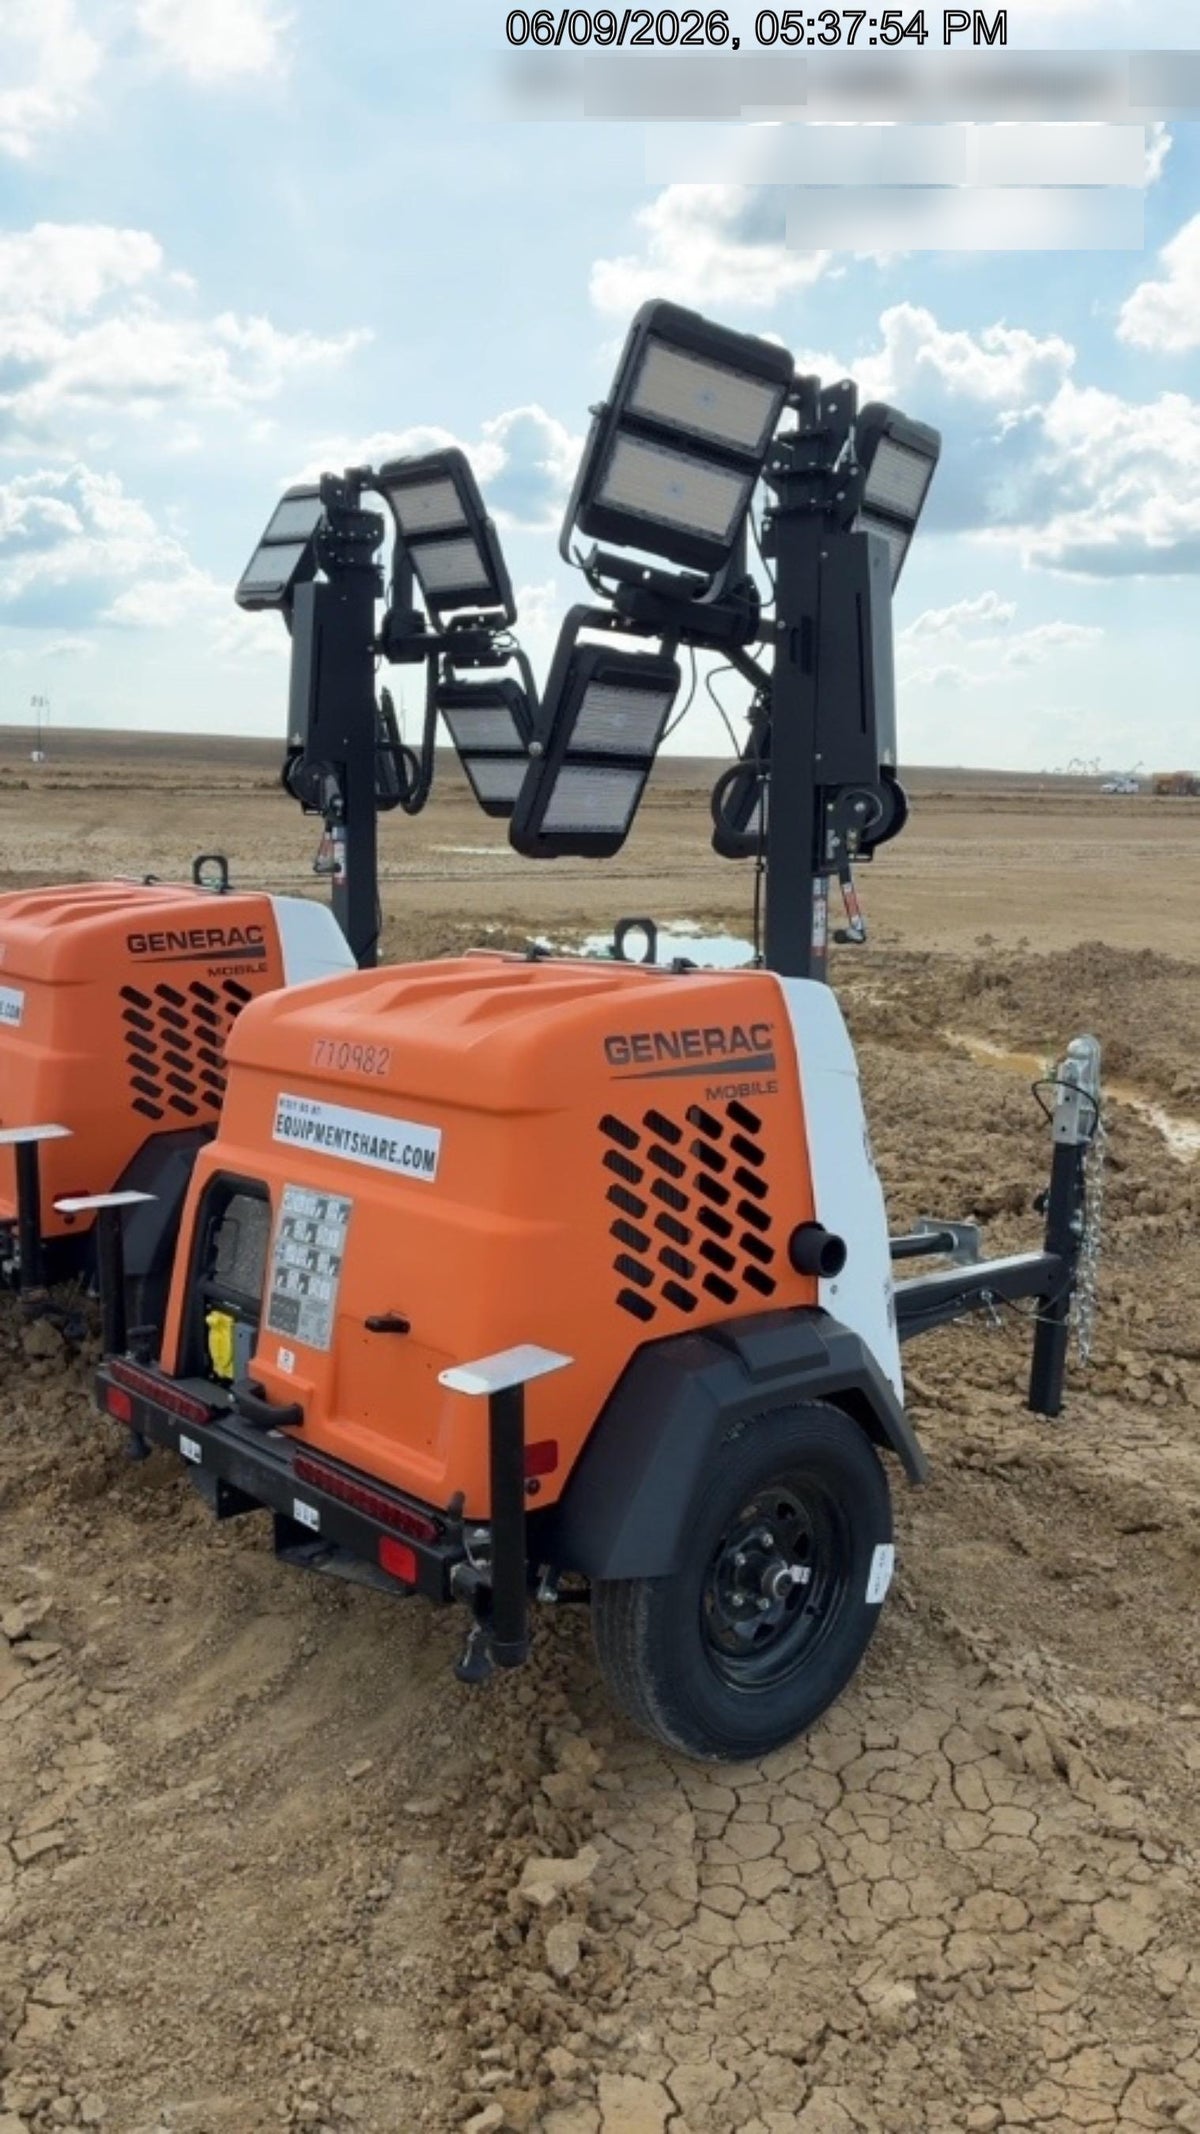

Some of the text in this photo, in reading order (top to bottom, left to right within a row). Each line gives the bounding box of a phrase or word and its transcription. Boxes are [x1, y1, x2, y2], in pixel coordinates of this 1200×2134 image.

[127, 925, 264, 953] GENERAC
[208, 963, 267, 977] MOBILE
[314, 1040, 390, 1075] 710982
[604, 1023, 773, 1065] GENERAC
[706, 1081, 778, 1101] MOBILE
[275, 1113, 436, 1172] EQUIPMENTSHARE.COM
